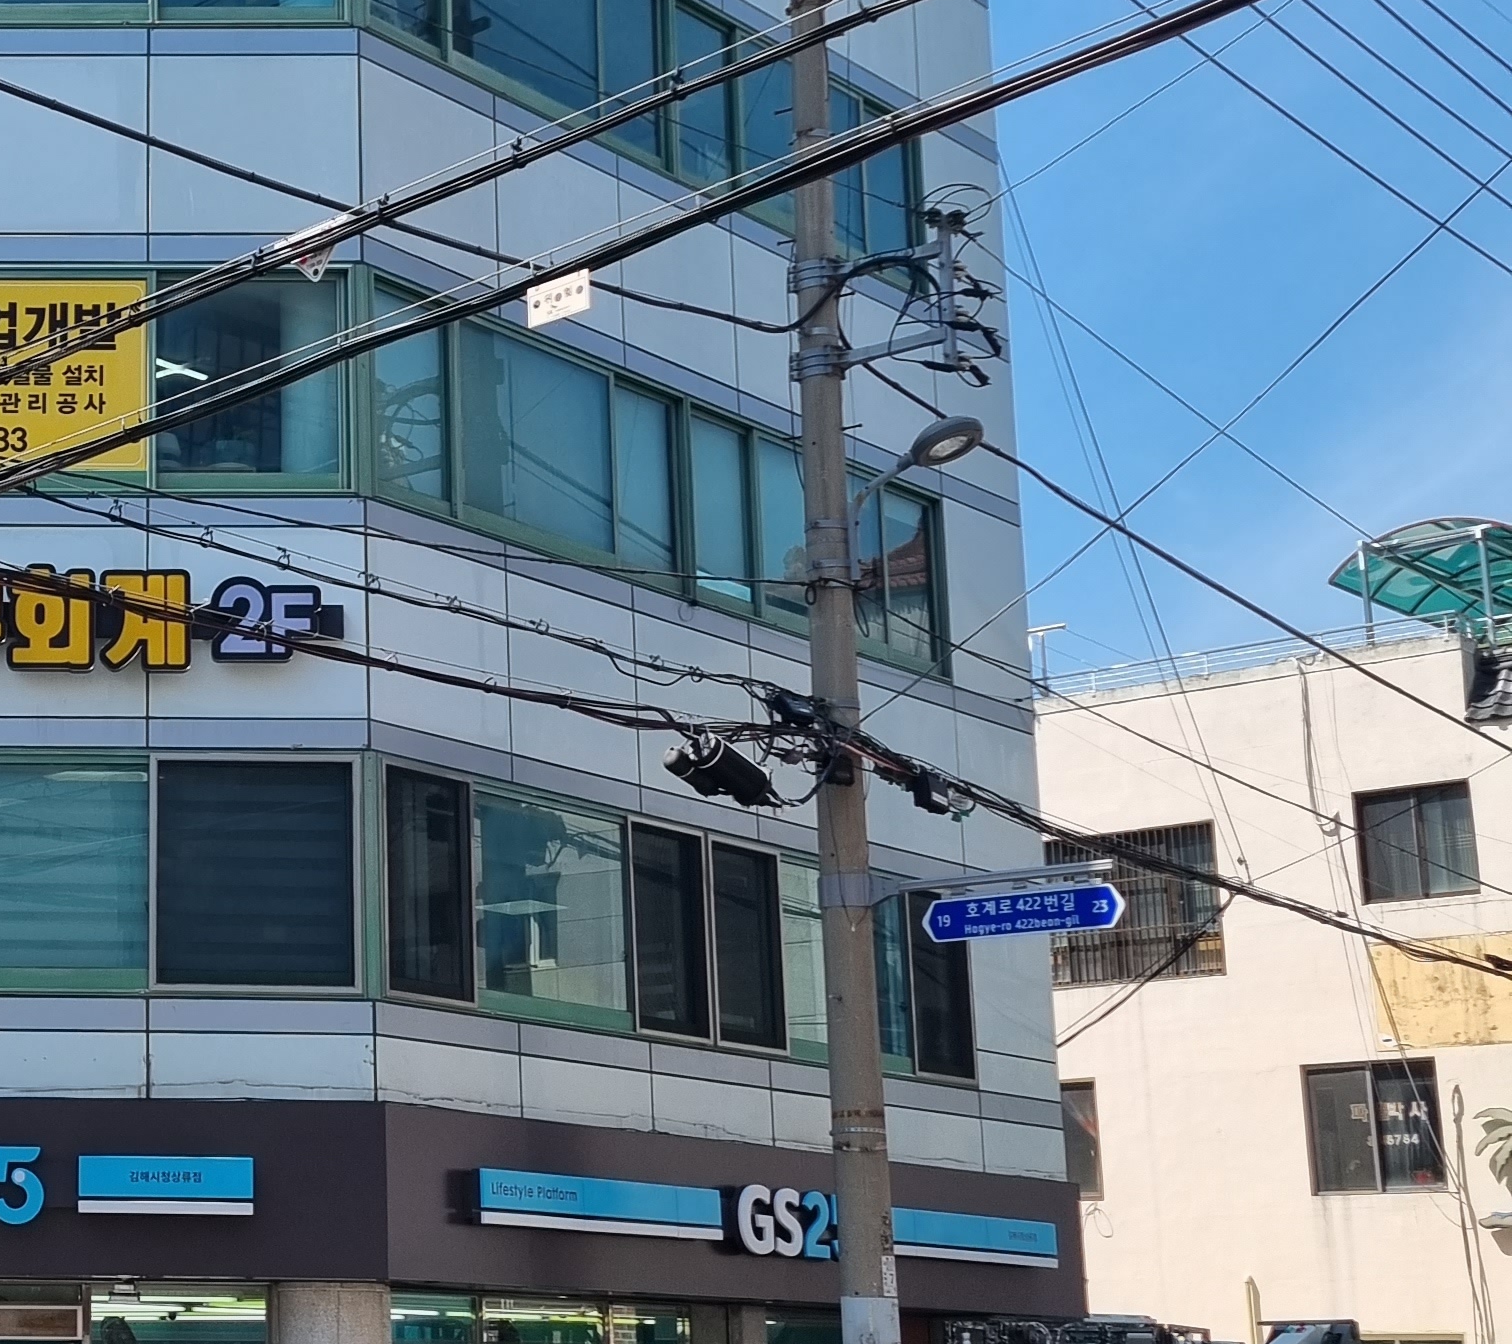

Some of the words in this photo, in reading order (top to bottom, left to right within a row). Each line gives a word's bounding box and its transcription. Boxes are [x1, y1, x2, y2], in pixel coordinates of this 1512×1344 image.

[62, 364, 105, 387] 설치
[215, 578, 320, 658] 2F
[1091, 899, 1109, 914] 23
[936, 914, 952, 928] 19
[964, 921, 1013, 937] Hogye-ro
[1014, 914, 1081, 930] 422beon-gil
[491, 1181, 534, 1201] Lifestyle
[537, 1184, 579, 1203] Platform
[737, 1183, 839, 1262] GS2
